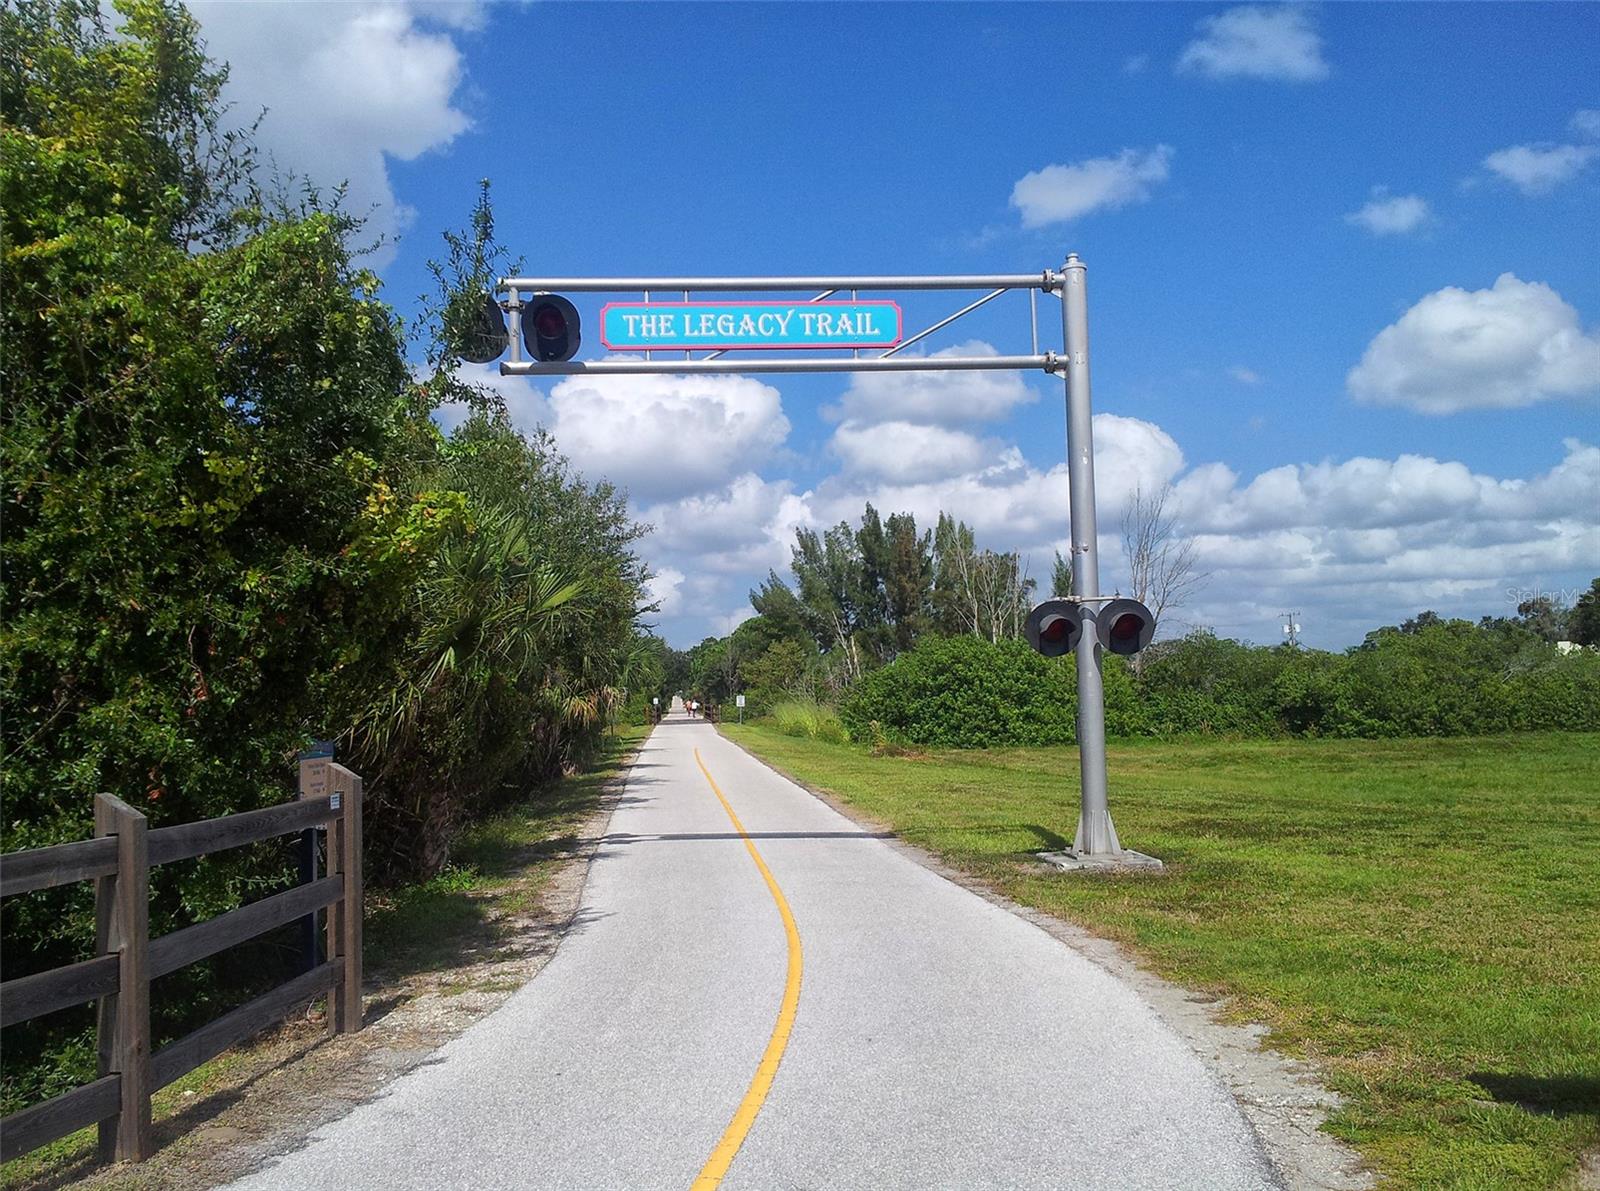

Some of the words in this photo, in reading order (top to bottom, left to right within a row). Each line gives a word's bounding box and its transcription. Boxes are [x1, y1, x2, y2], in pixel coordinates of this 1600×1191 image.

[622, 314, 676, 337] THE
[684, 309, 795, 337] LEGACY
[798, 312, 881, 337] TRAIL
